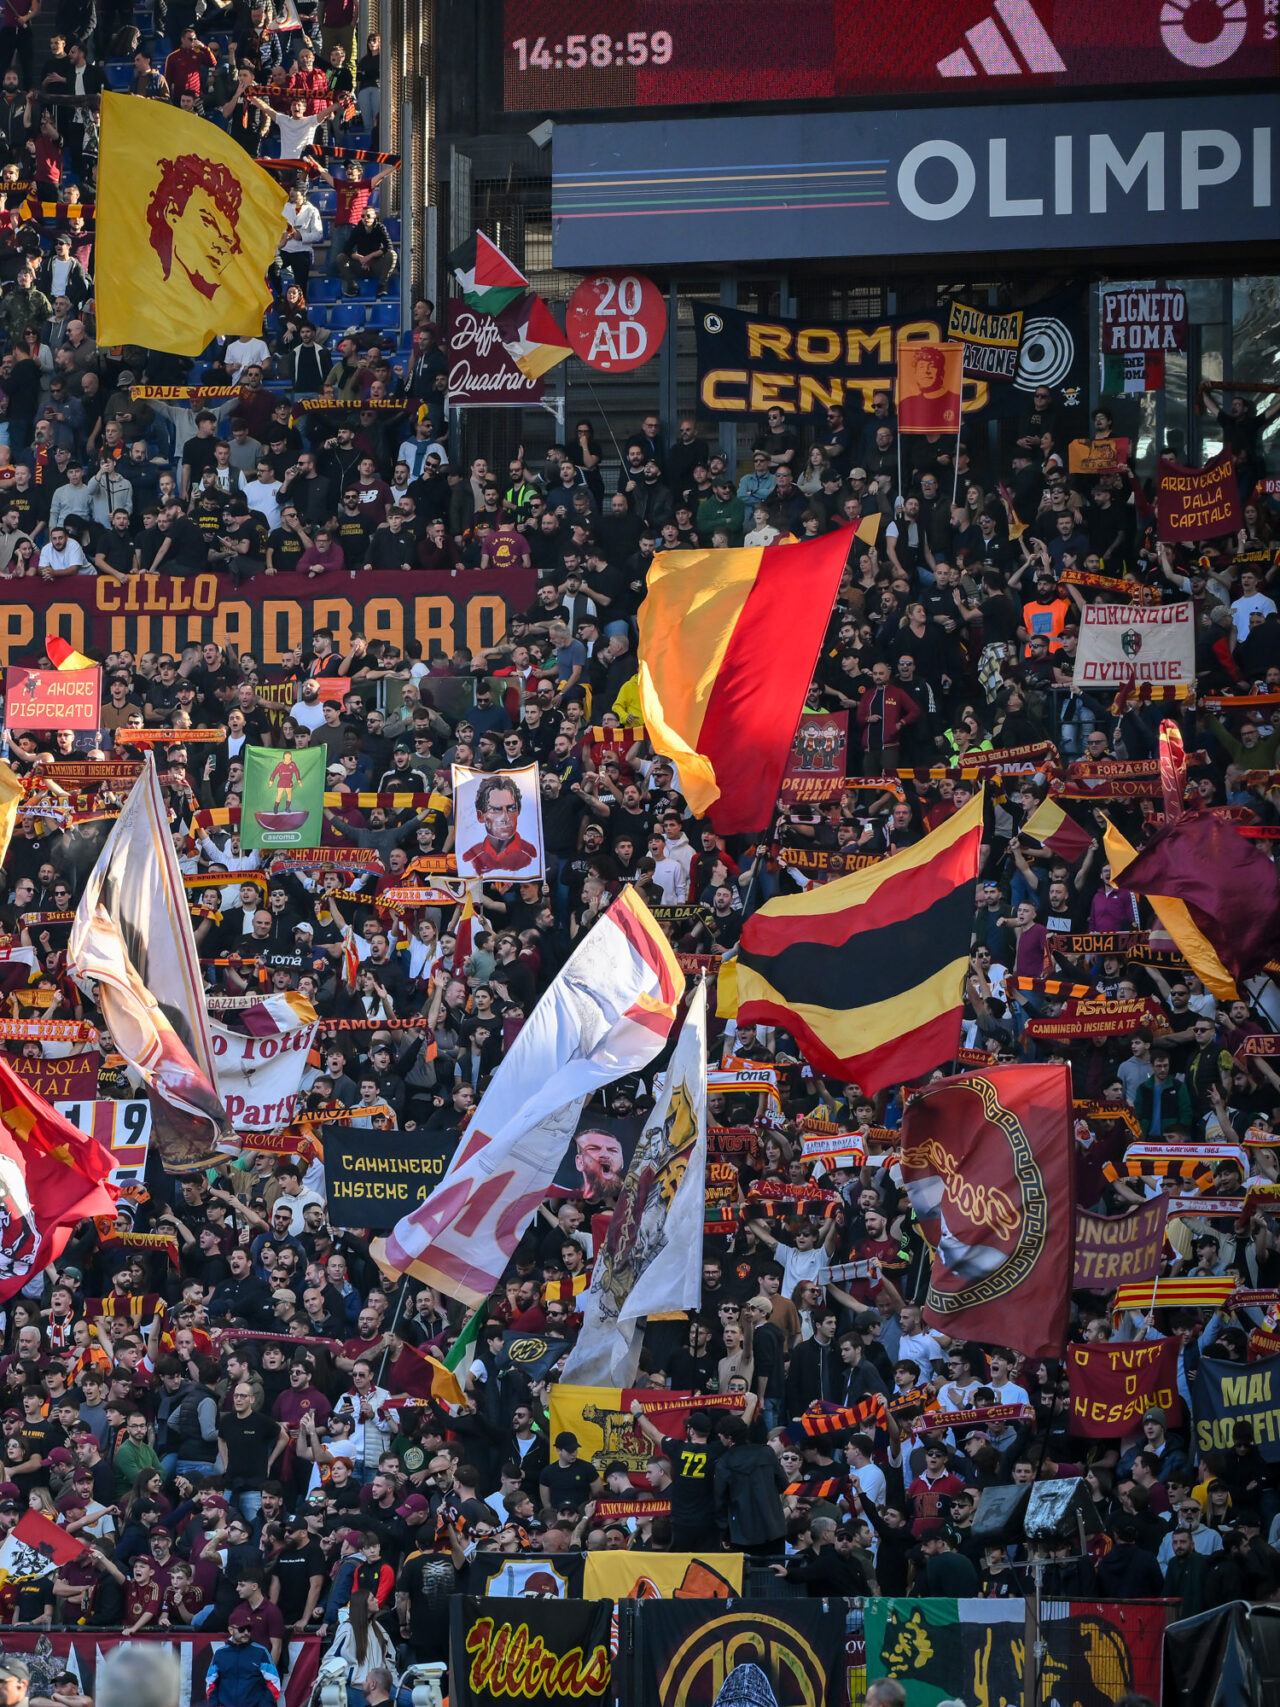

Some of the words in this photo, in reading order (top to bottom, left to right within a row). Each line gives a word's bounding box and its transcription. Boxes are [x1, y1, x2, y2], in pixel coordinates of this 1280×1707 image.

[513, 29, 673, 71] 14:58:59
[897, 126, 1273, 222] OLIMPI
[594, 276, 643, 317] 20
[1105, 292, 1185, 324] PIGNETO
[950, 304, 1019, 341] SQUADRA
[587, 321, 648, 361] AD
[1111, 324, 1177, 350] ROMA
[956, 342, 1018, 377] AZIONE
[145, 385, 182, 397] DAJE
[197, 385, 241, 397] ROMA
[701, 369, 990, 414] CENTO
[1183, 487, 1223, 510] DALLA
[1170, 502, 1232, 528] CAPITALE
[96, 573, 219, 612] CILLO
[1084, 604, 1191, 626] COMUNQUE
[1083, 660, 1182, 682] OVUNQUE
[47, 682, 94, 697] AMORE
[10, 702, 94, 718] DISPERATO
[988, 750, 1008, 760] SOLO
[1009, 746, 1030, 757] STAR
[88, 765, 114, 776] INSIEME
[122, 765, 132, 775] TE
[1096, 763, 1134, 775] FORZA
[781, 776, 845, 791] DRINKING
[795, 789, 833, 801] TEAM
[267, 833, 296, 841] asroma
[786, 849, 828, 867] DAJE
[1073, 936, 1114, 952] ROMA
[270, 954, 302, 966] roma
[1076, 999, 1146, 1017] ASROMA
[1032, 1021, 1082, 1035] CAMMINERÒ
[1083, 1020, 1116, 1034] INSIEME
[1125, 1019, 1136, 1030] TE
[240, 1025, 314, 1060] Totti
[45, 1057, 92, 1075] SOLA
[736, 1070, 770, 1082] roma
[224, 1093, 297, 1126] Party
[245, 1133, 285, 1148] ROMA
[341, 1154, 447, 1176] CAMMINERO'
[333, 1180, 409, 1201] INSIEME
[123, 1234, 169, 1247] ROMA
[1220, 1371, 1272, 1408] MAI
[1075, 1388, 1173, 1423] NESSUNO
[680, 1450, 708, 1478] 72
[466, 1616, 612, 1698] Ultras
